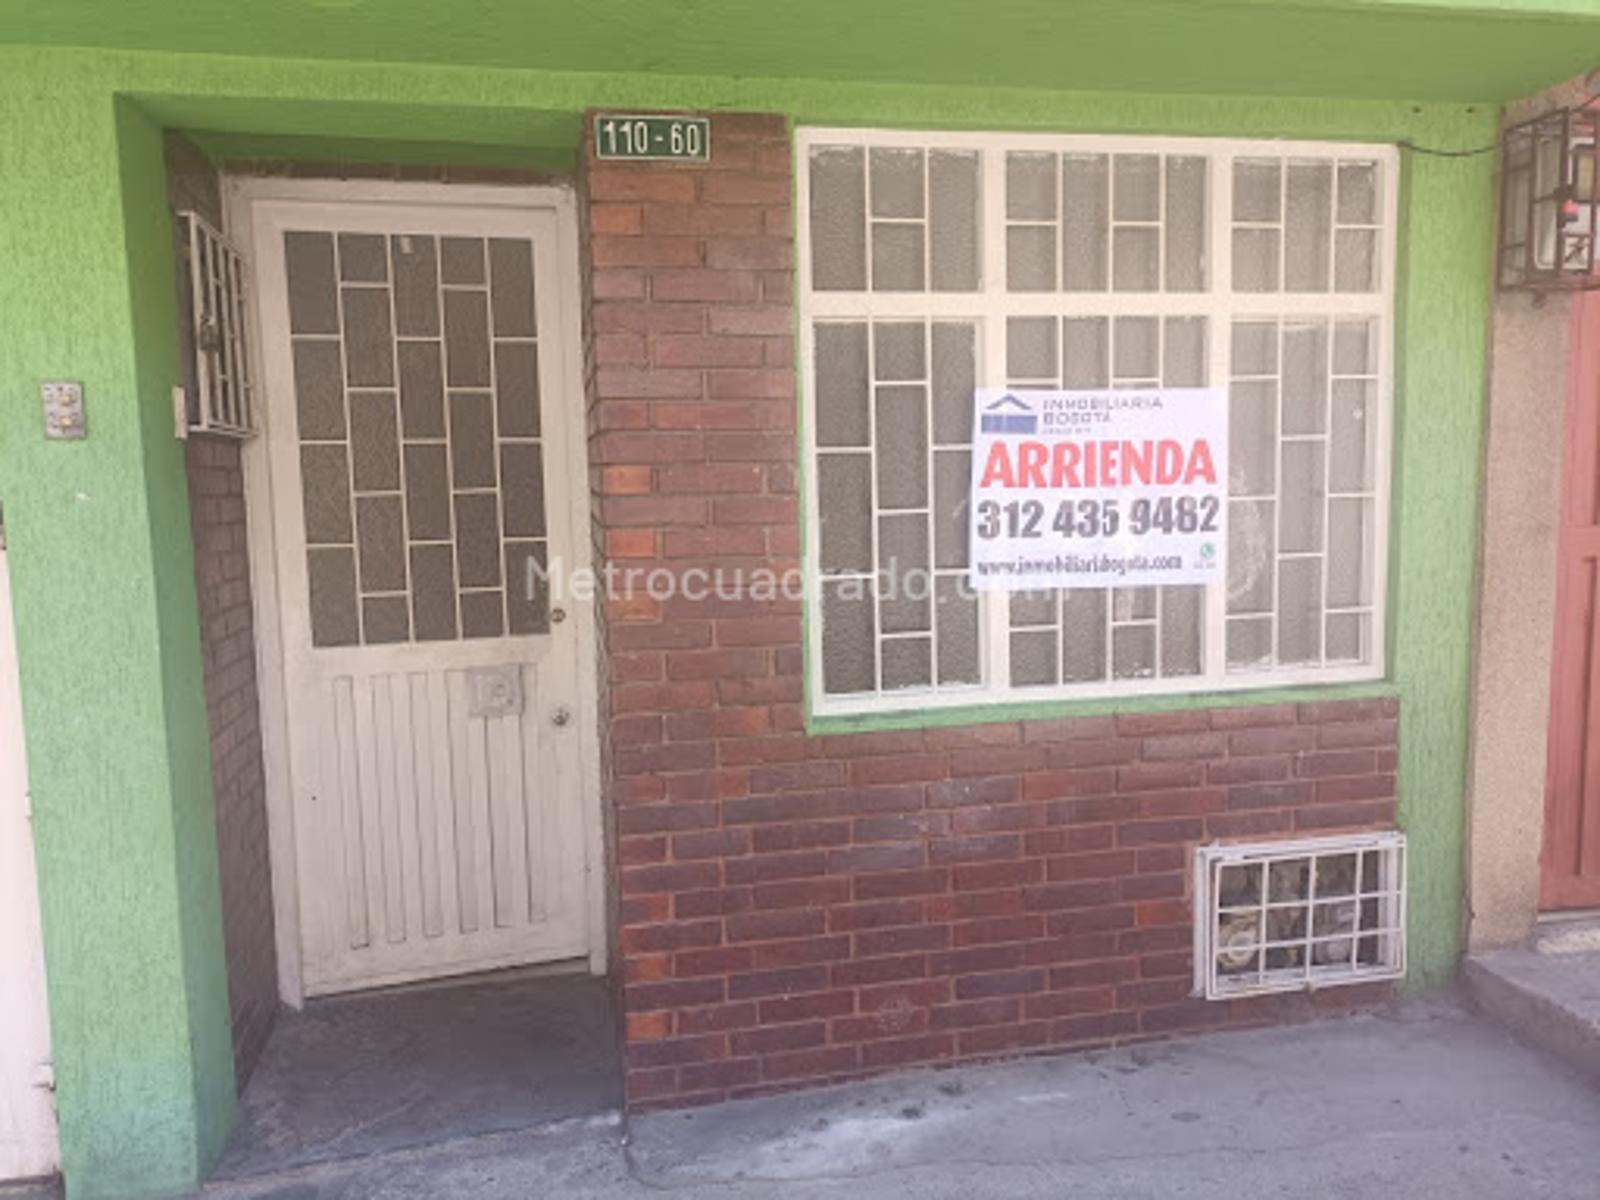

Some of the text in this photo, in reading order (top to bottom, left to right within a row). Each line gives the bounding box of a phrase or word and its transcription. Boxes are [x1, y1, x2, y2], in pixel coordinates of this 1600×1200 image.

[980, 438, 1217, 488] ARRIENDA
[977, 495, 1220, 538] 312 435 9482
